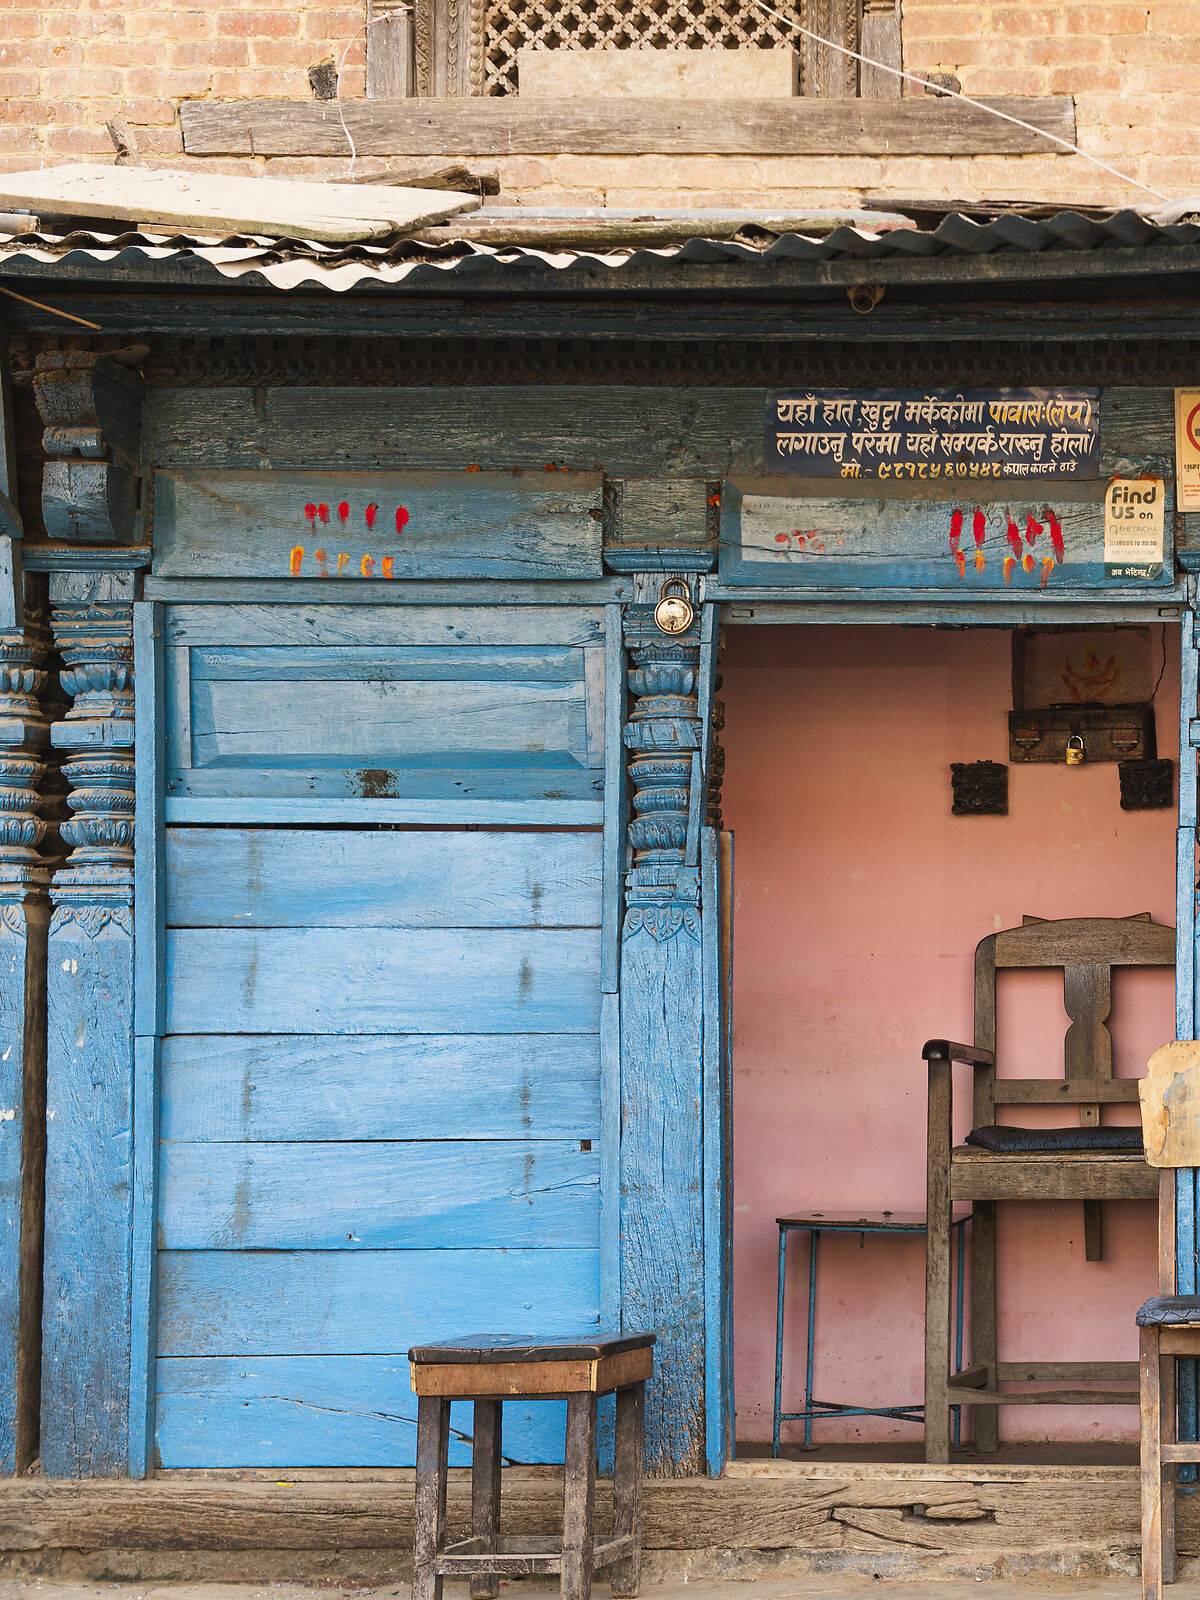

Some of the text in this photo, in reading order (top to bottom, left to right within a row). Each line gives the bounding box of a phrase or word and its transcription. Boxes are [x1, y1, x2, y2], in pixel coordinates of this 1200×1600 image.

[777, 392, 819, 427] यहाँ
[860, 400, 902, 431] खुट्टा
[776, 432, 848, 463] लगाउनु
[851, 427, 902, 457] परेमा
[906, 427, 940, 458] यहाँ
[940, 424, 998, 457] सम्पर्क
